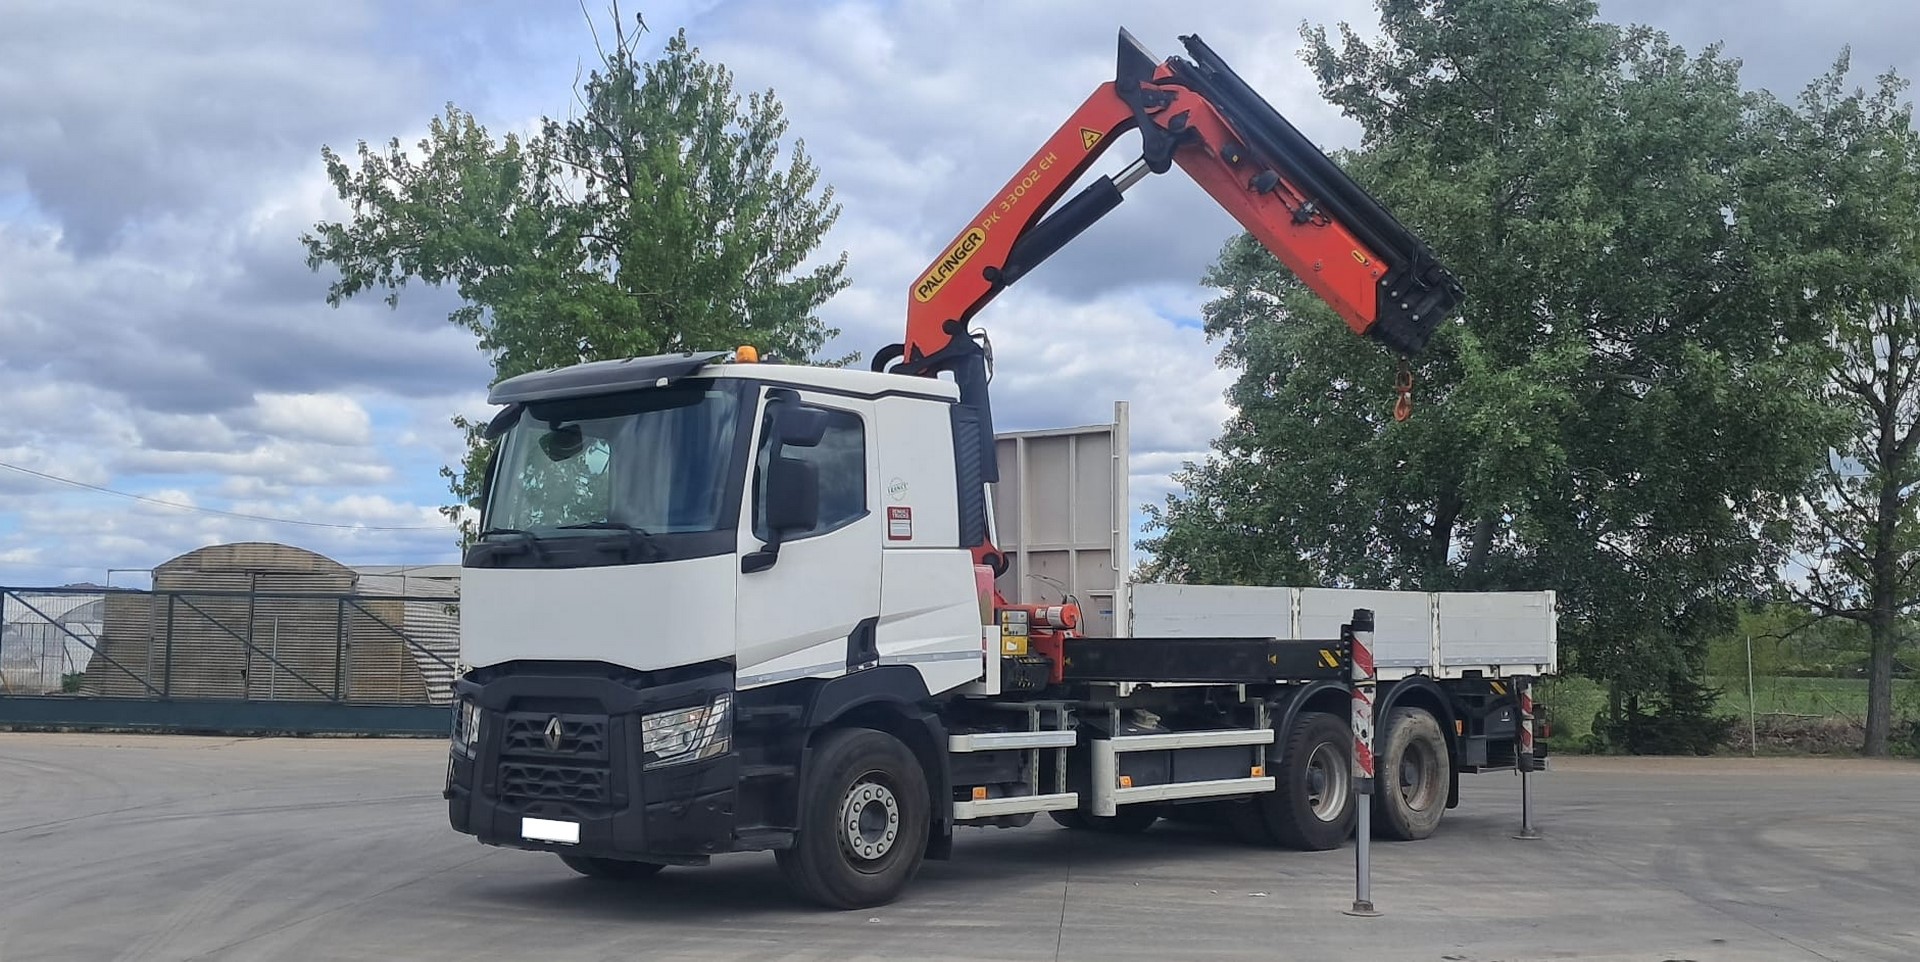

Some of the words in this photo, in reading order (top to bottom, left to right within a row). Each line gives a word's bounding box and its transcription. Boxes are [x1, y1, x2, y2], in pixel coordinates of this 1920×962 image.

[918, 232, 982, 299] PALFINGER
[982, 211, 1001, 231] PK
[999, 170, 1041, 212] 33002
[1039, 152, 1057, 171] EH
